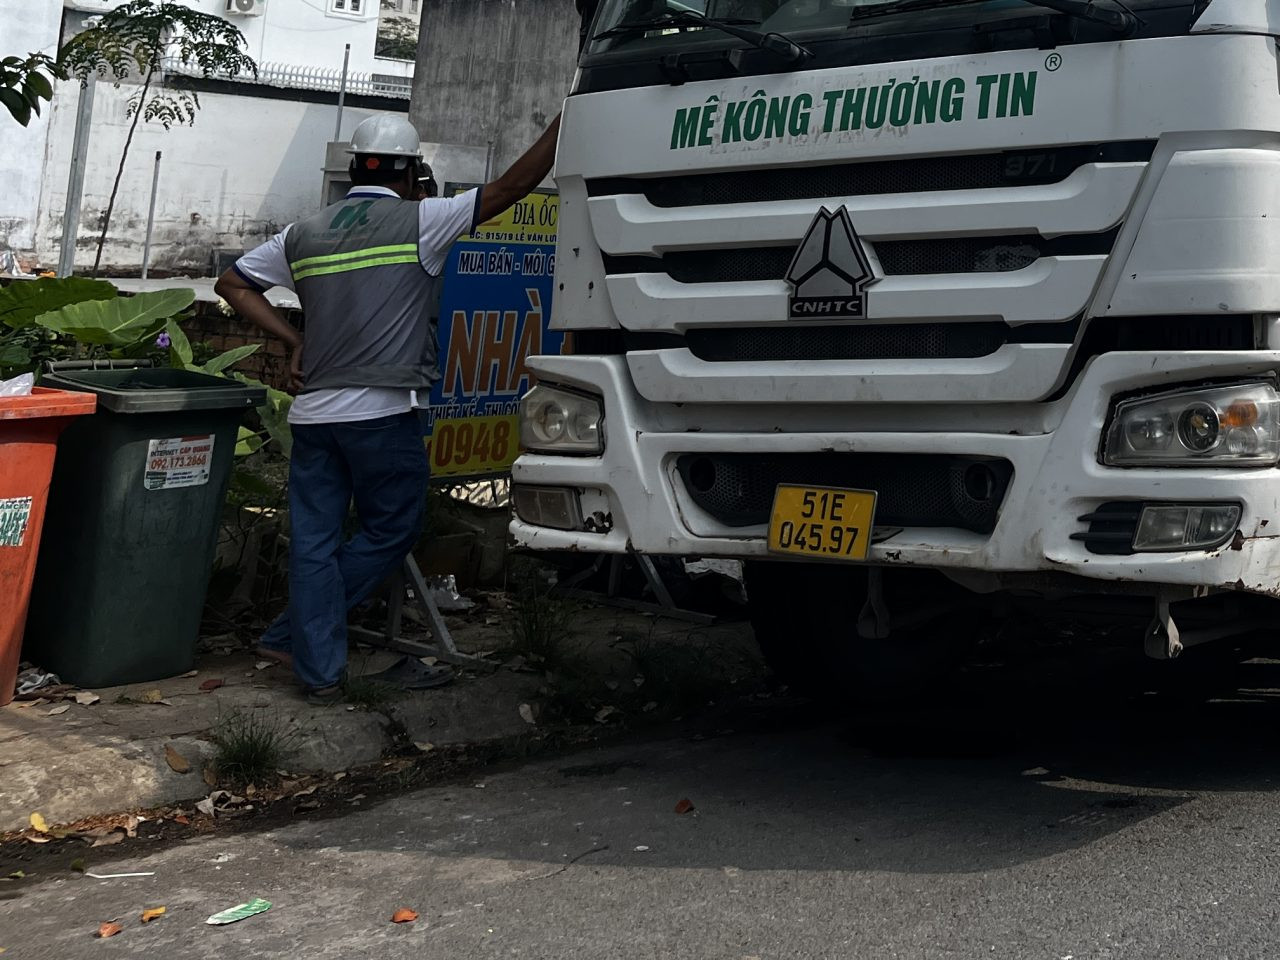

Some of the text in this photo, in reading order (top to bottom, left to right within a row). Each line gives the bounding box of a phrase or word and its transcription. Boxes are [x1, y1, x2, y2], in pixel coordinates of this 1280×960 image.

[670, 95, 719, 150] MÊ
[721, 90, 813, 144] KÔNG
[823, 76, 966, 133] THƯƠNG
[976, 71, 1038, 120] TIN
[512, 194, 558, 230] ĐỊA ỐC
[485, 232, 514, 241] 915/19
[457, 251, 486, 275] MUA
[486, 247, 514, 275] BÁN
[522, 248, 546, 276] MÔI
[792, 300, 860, 313] CNHTC
[442, 288, 542, 398] NHÀ
[435, 421, 511, 467] 0948
[801, 491, 846, 522] 51E
[780, 521, 859, 555] 045.97
